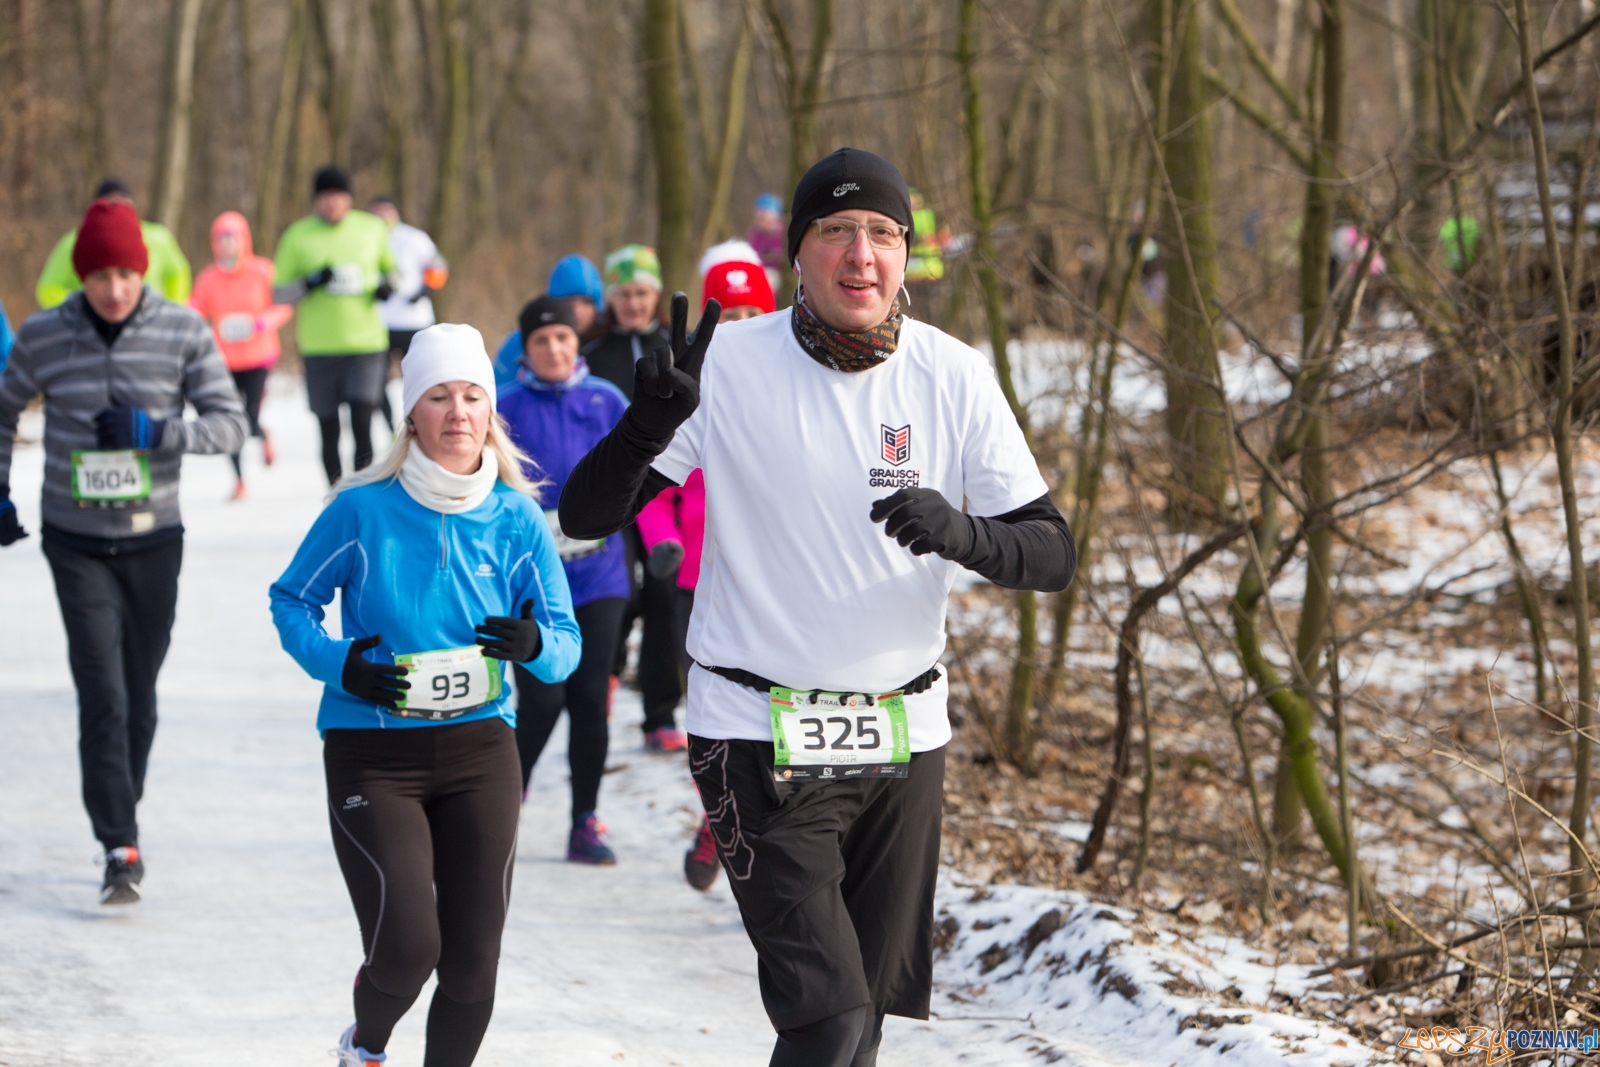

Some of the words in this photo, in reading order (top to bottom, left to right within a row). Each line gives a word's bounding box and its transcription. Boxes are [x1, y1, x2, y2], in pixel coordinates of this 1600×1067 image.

[85, 468, 136, 490] 1604
[869, 468, 920, 479] GRAUSCH
[869, 478, 920, 489] GRAUSCH
[432, 672, 470, 701] 93
[800, 716, 880, 750] 325
[830, 754, 857, 763] PIOTR
